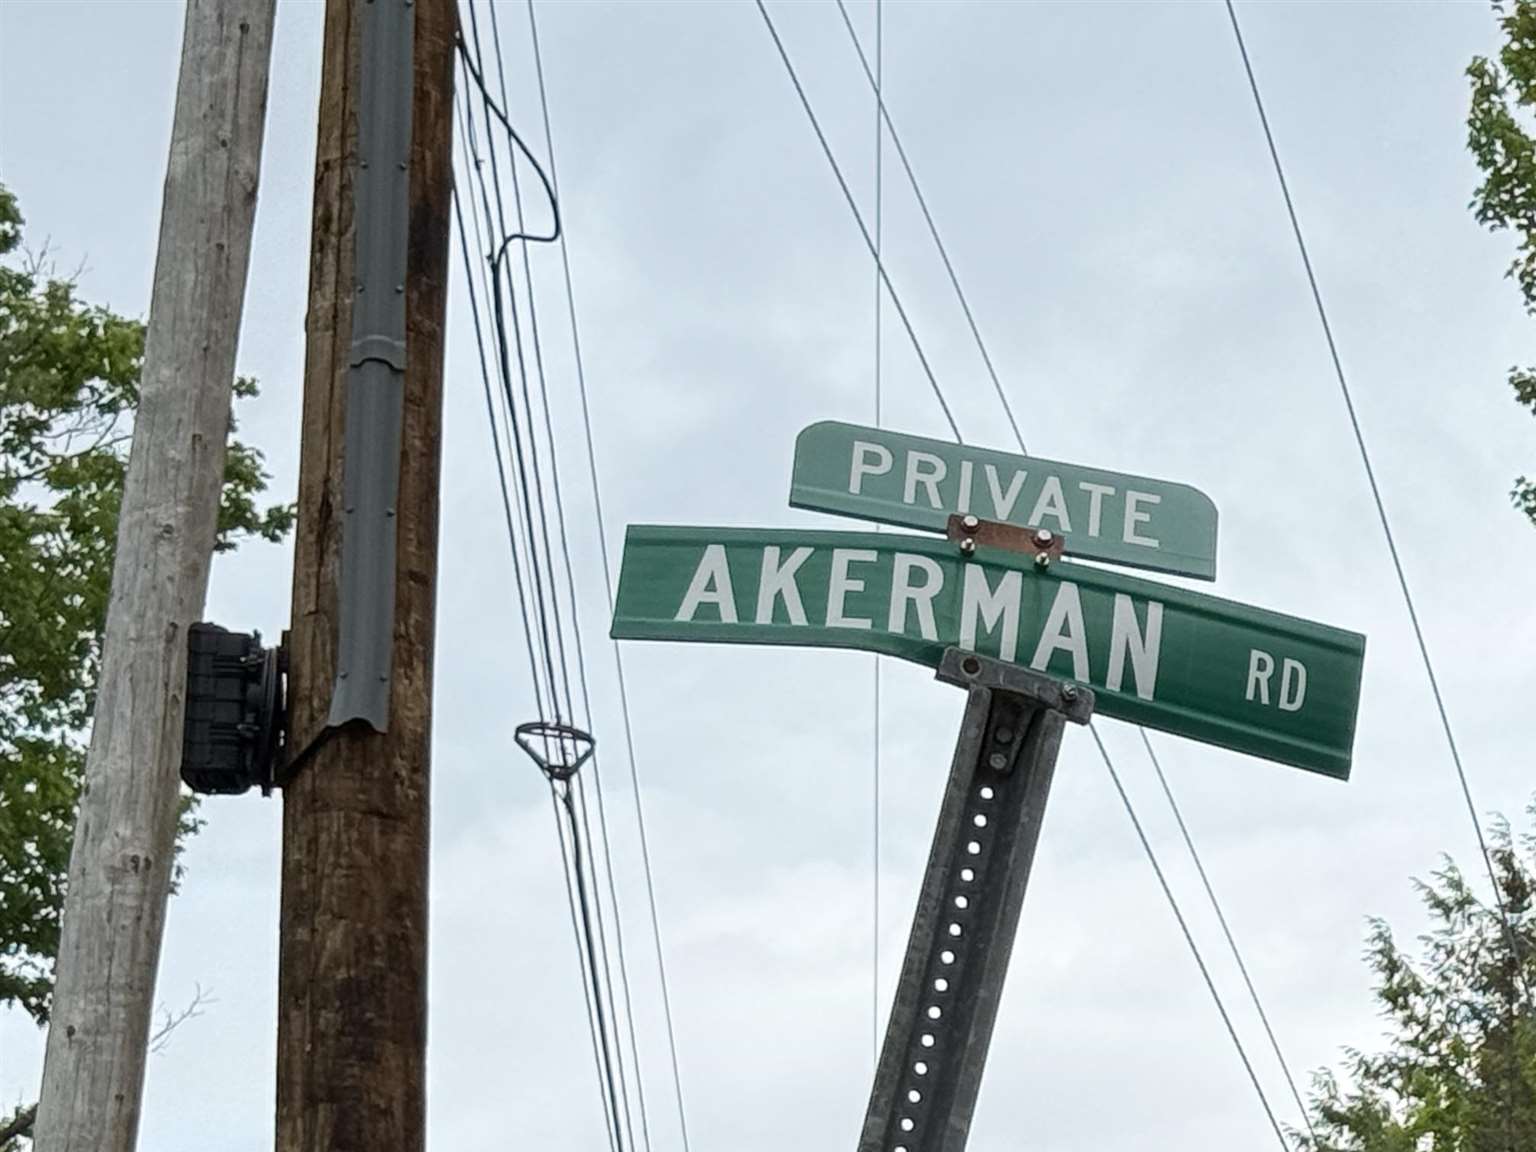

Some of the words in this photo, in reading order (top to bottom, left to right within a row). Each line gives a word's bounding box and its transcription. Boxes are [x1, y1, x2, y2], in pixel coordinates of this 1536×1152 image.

[848, 441, 1161, 546] PRIVATE
[674, 544, 1163, 701] AKERMAN
[1245, 649, 1306, 711] RD
